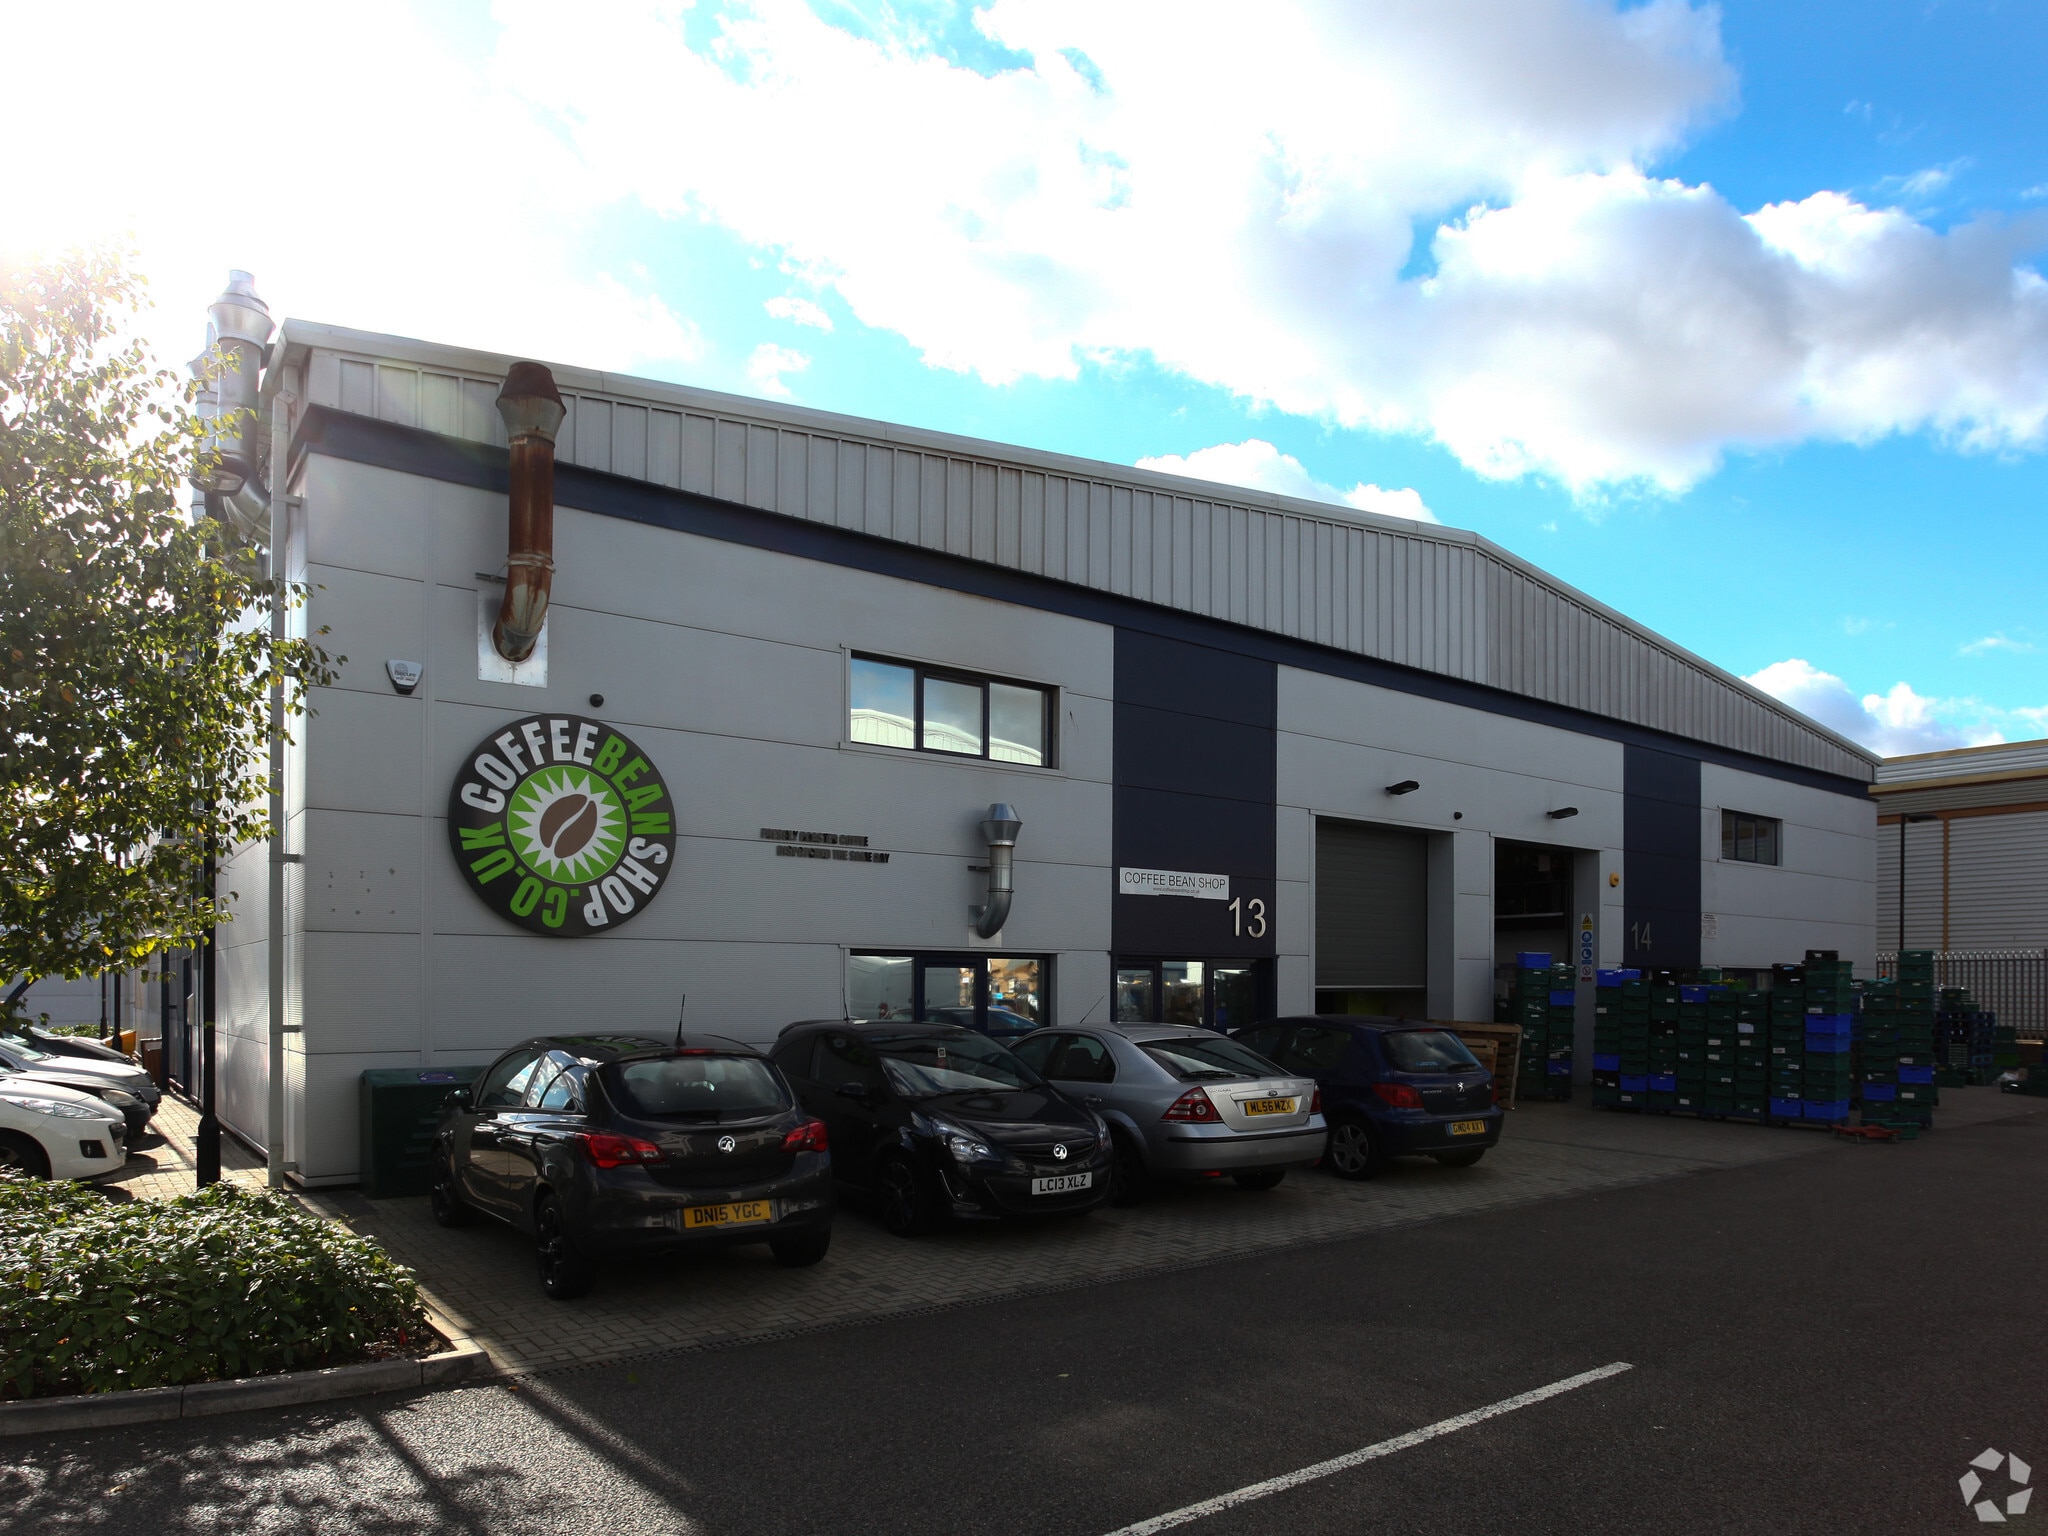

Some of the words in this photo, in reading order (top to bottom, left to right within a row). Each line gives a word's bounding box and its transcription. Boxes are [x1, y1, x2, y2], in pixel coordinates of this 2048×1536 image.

[1124, 871, 1165, 886] COFFEE
[1168, 875, 1196, 888] BEAN
[1198, 877, 1226, 890] SHOP
[1228, 896, 1267, 938] 13
[1631, 921, 1652, 951] 14
[1039, 1178, 1065, 1192] LC13
[1067, 1174, 1087, 1189] XLZ
[694, 1206, 728, 1225] DN15
[732, 1202, 762, 1220] YGC
